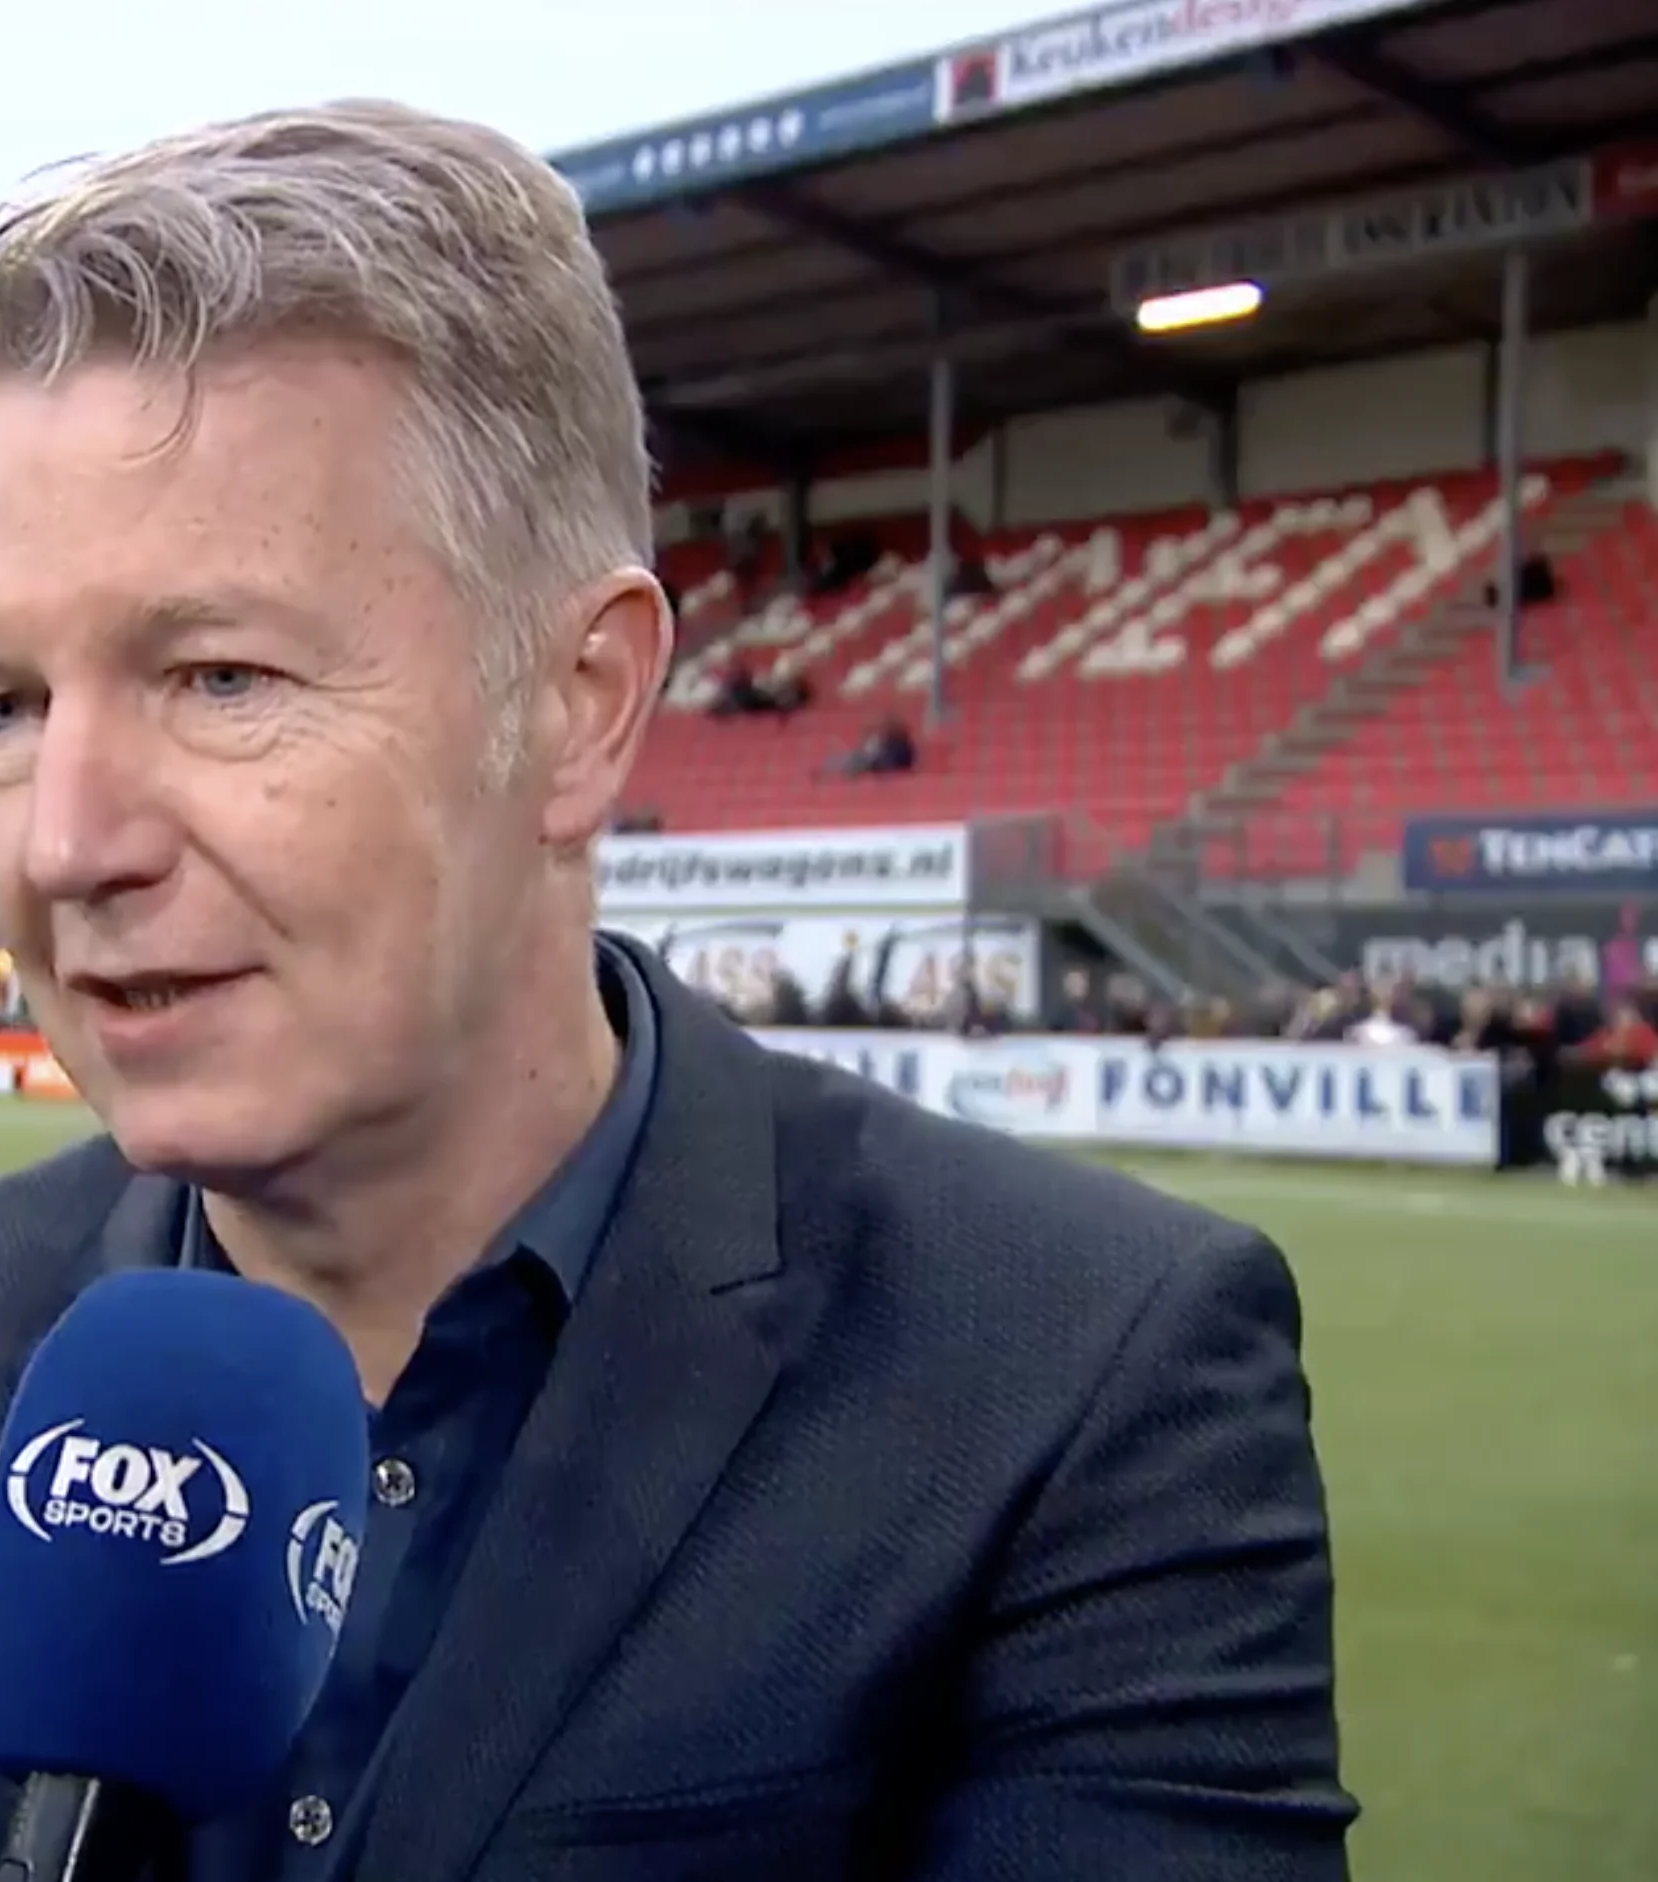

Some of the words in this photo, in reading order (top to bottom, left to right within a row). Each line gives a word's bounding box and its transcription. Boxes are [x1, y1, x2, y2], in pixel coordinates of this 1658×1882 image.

[1362, 917, 1600, 989] media
[1099, 1056, 1489, 1119] FONVILLE
[49, 1435, 202, 1520] FOX
[43, 1498, 187, 1547] SPORTS
[313, 1516, 359, 1612] FO
[305, 1580, 343, 1630] SPO
